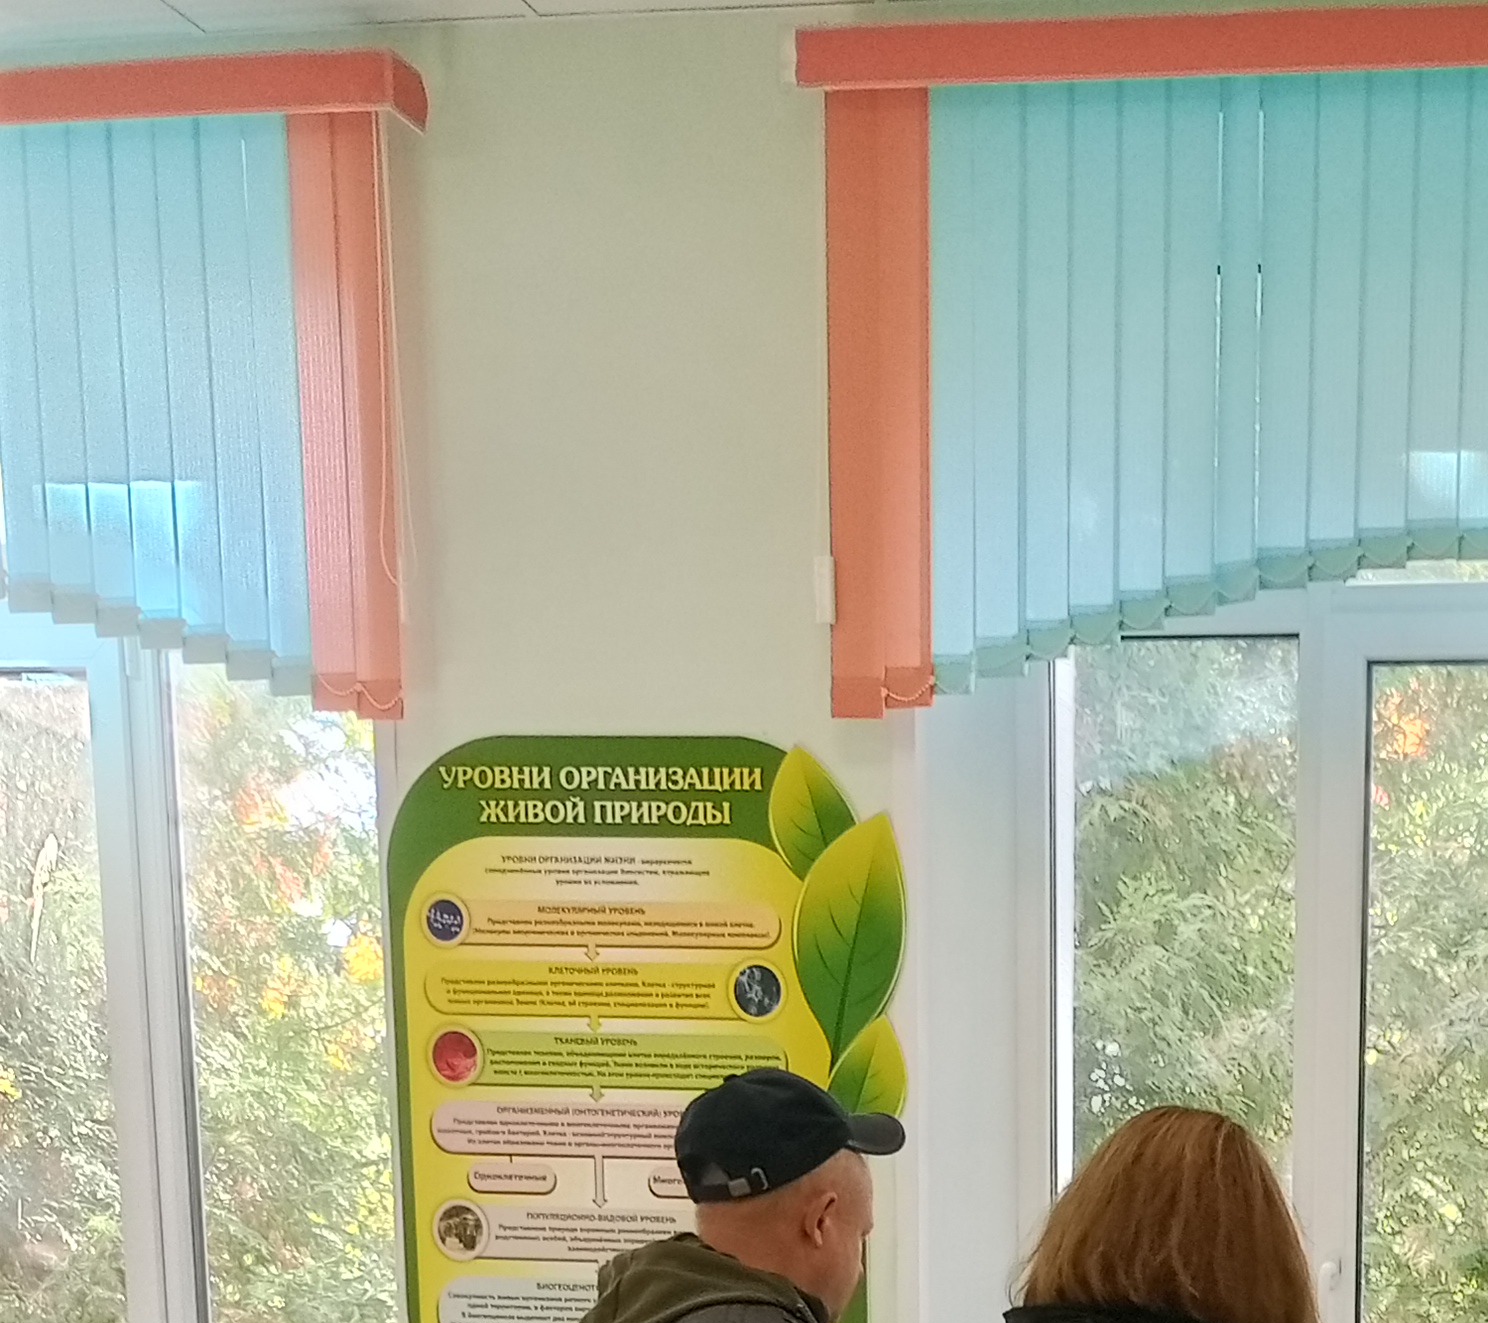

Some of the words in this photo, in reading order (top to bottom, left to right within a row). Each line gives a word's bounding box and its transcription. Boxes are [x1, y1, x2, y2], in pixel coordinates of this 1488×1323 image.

[438, 766, 551, 790] УРОВНИ
[559, 766, 763, 792] ОРГАНИЗАЦИИ
[479, 796, 585, 824] ЖИВОЙ
[594, 800, 731, 826] ПРИРОДЫ
